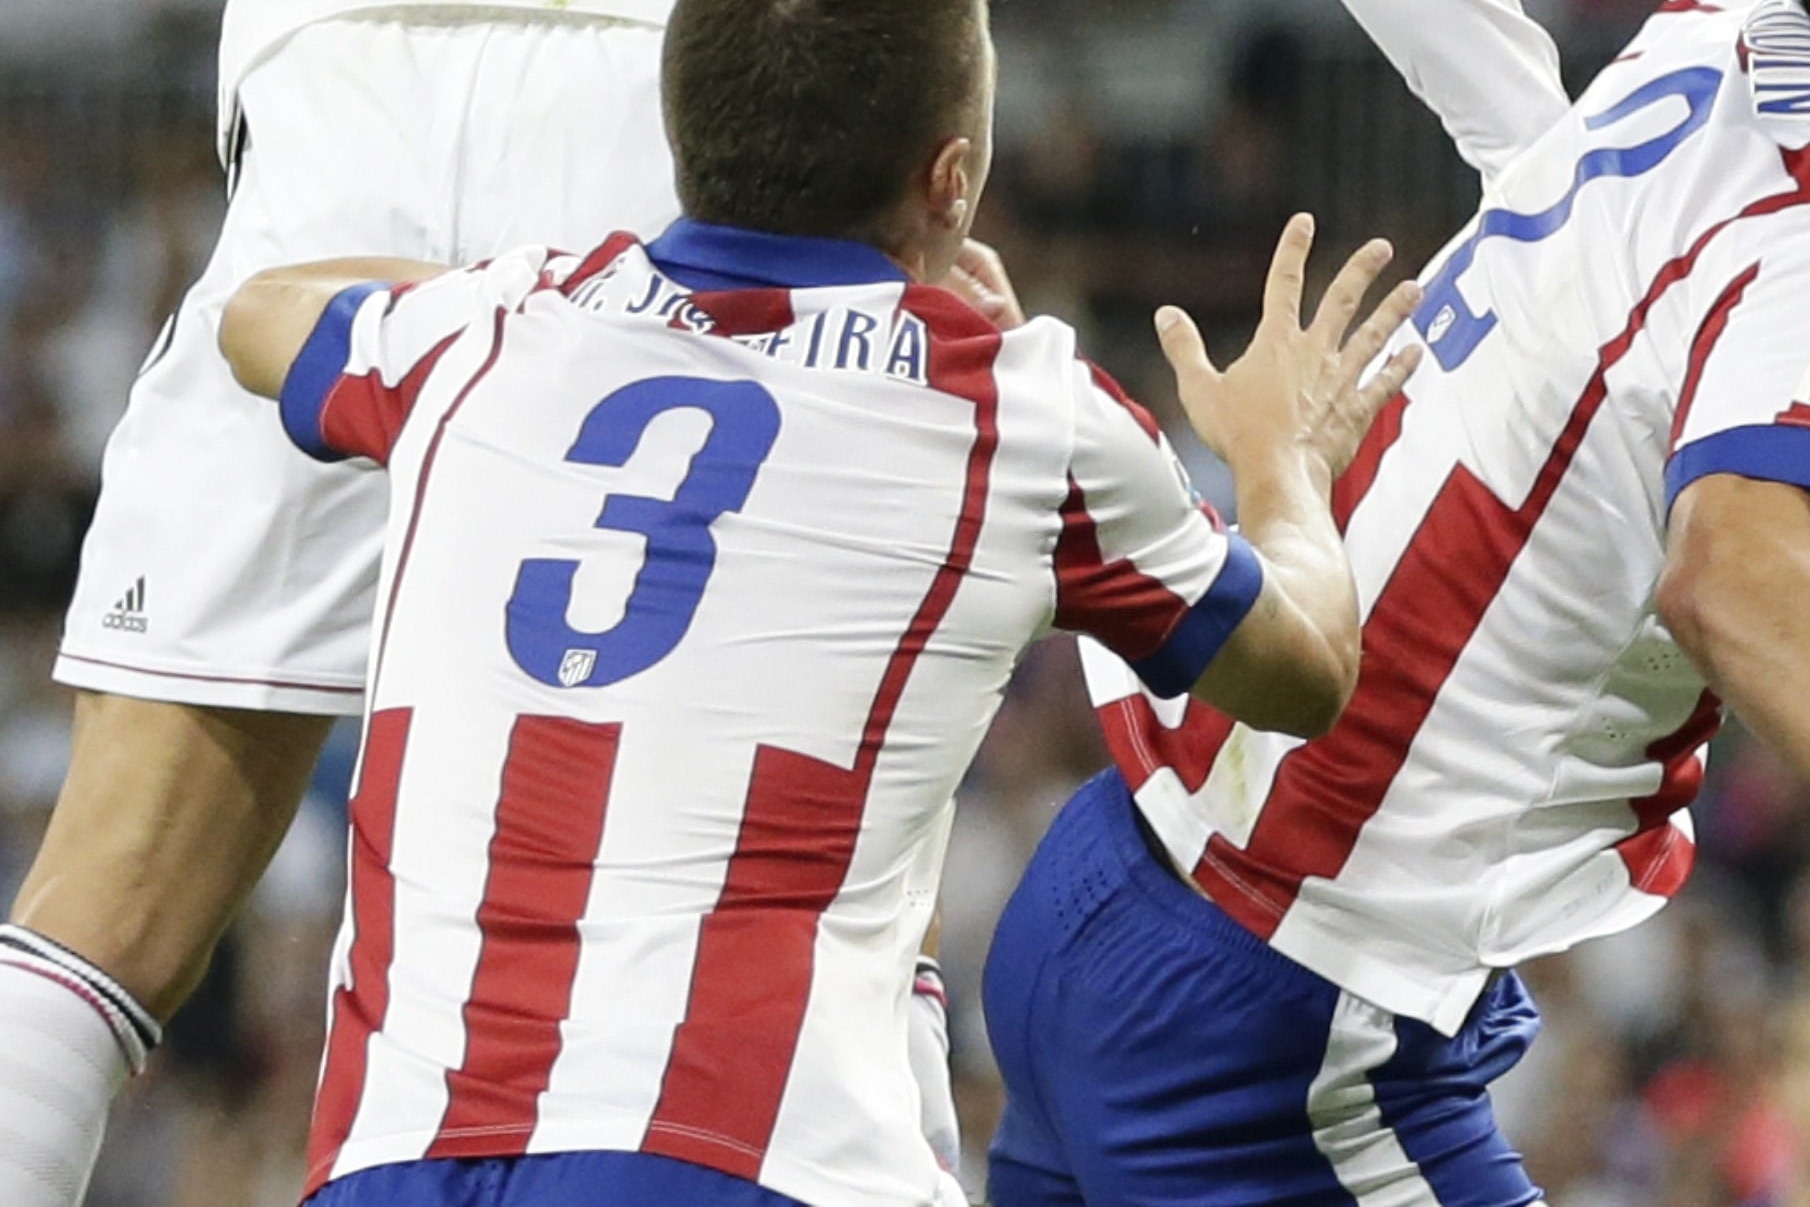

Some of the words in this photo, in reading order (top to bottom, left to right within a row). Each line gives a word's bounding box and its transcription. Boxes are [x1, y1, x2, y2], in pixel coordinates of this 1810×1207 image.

[1412, 65, 1724, 373] 2
[102, 609, 148, 634] adidas
[505, 375, 782, 688] 3
